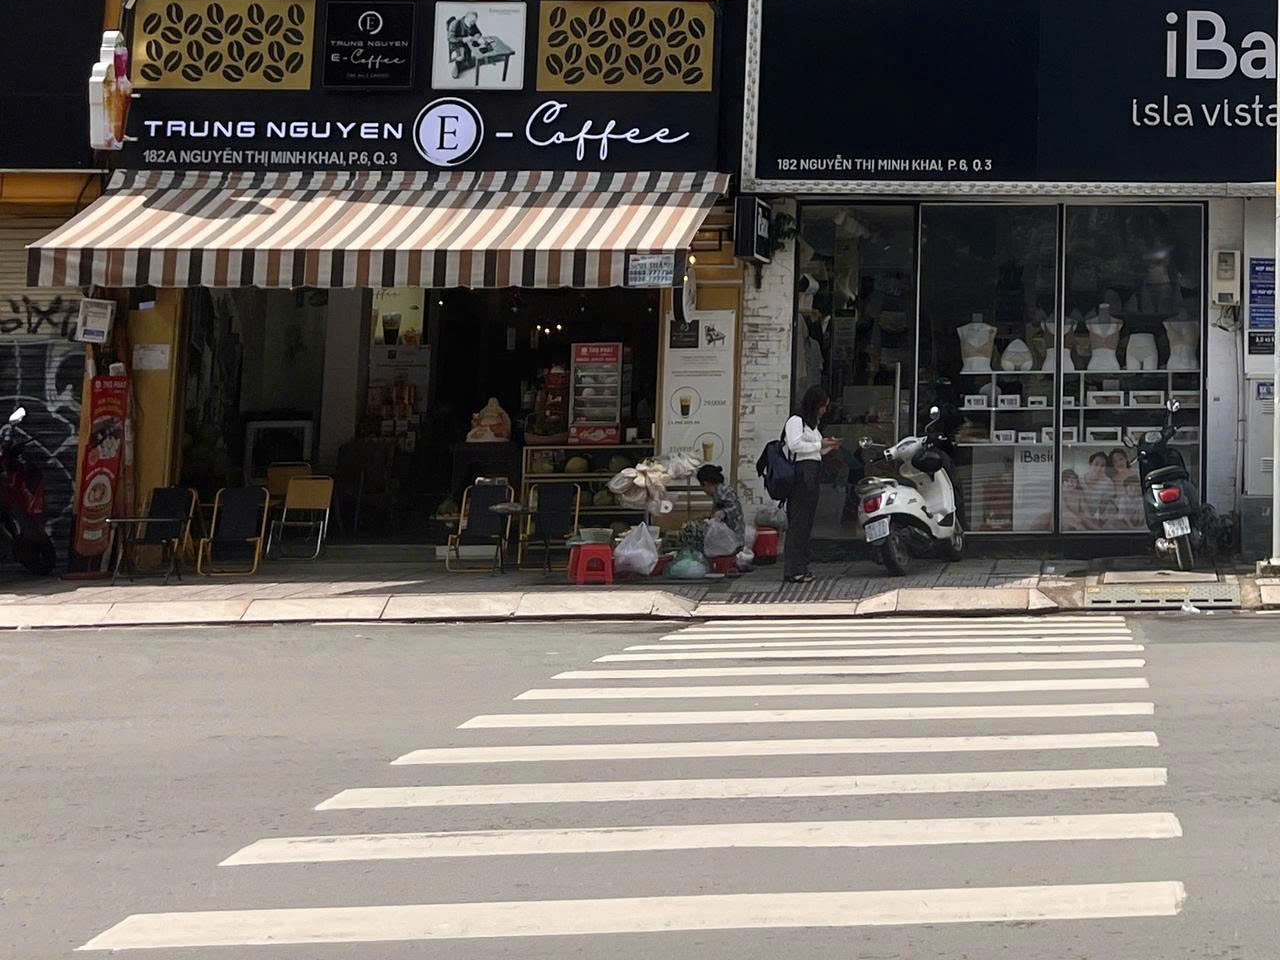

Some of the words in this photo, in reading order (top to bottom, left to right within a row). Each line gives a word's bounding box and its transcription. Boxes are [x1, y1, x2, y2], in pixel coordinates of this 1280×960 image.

[145, 120, 256, 138] TRUNG
[267, 121, 403, 140] NGUYEN
[143, 150, 177, 163] 182A
[180, 147, 245, 164] NGUYỄN
[246, 150, 269, 167] THỊ
[271, 151, 306, 165] MINH
[308, 151, 347, 167] KHAI,
[777, 158, 797, 170] 182
[800, 154, 852, 170] NGUYỄN
[854, 158, 875, 173] THỊ
[878, 159, 909, 170] MINH
[912, 159, 943, 172] KHAI,
